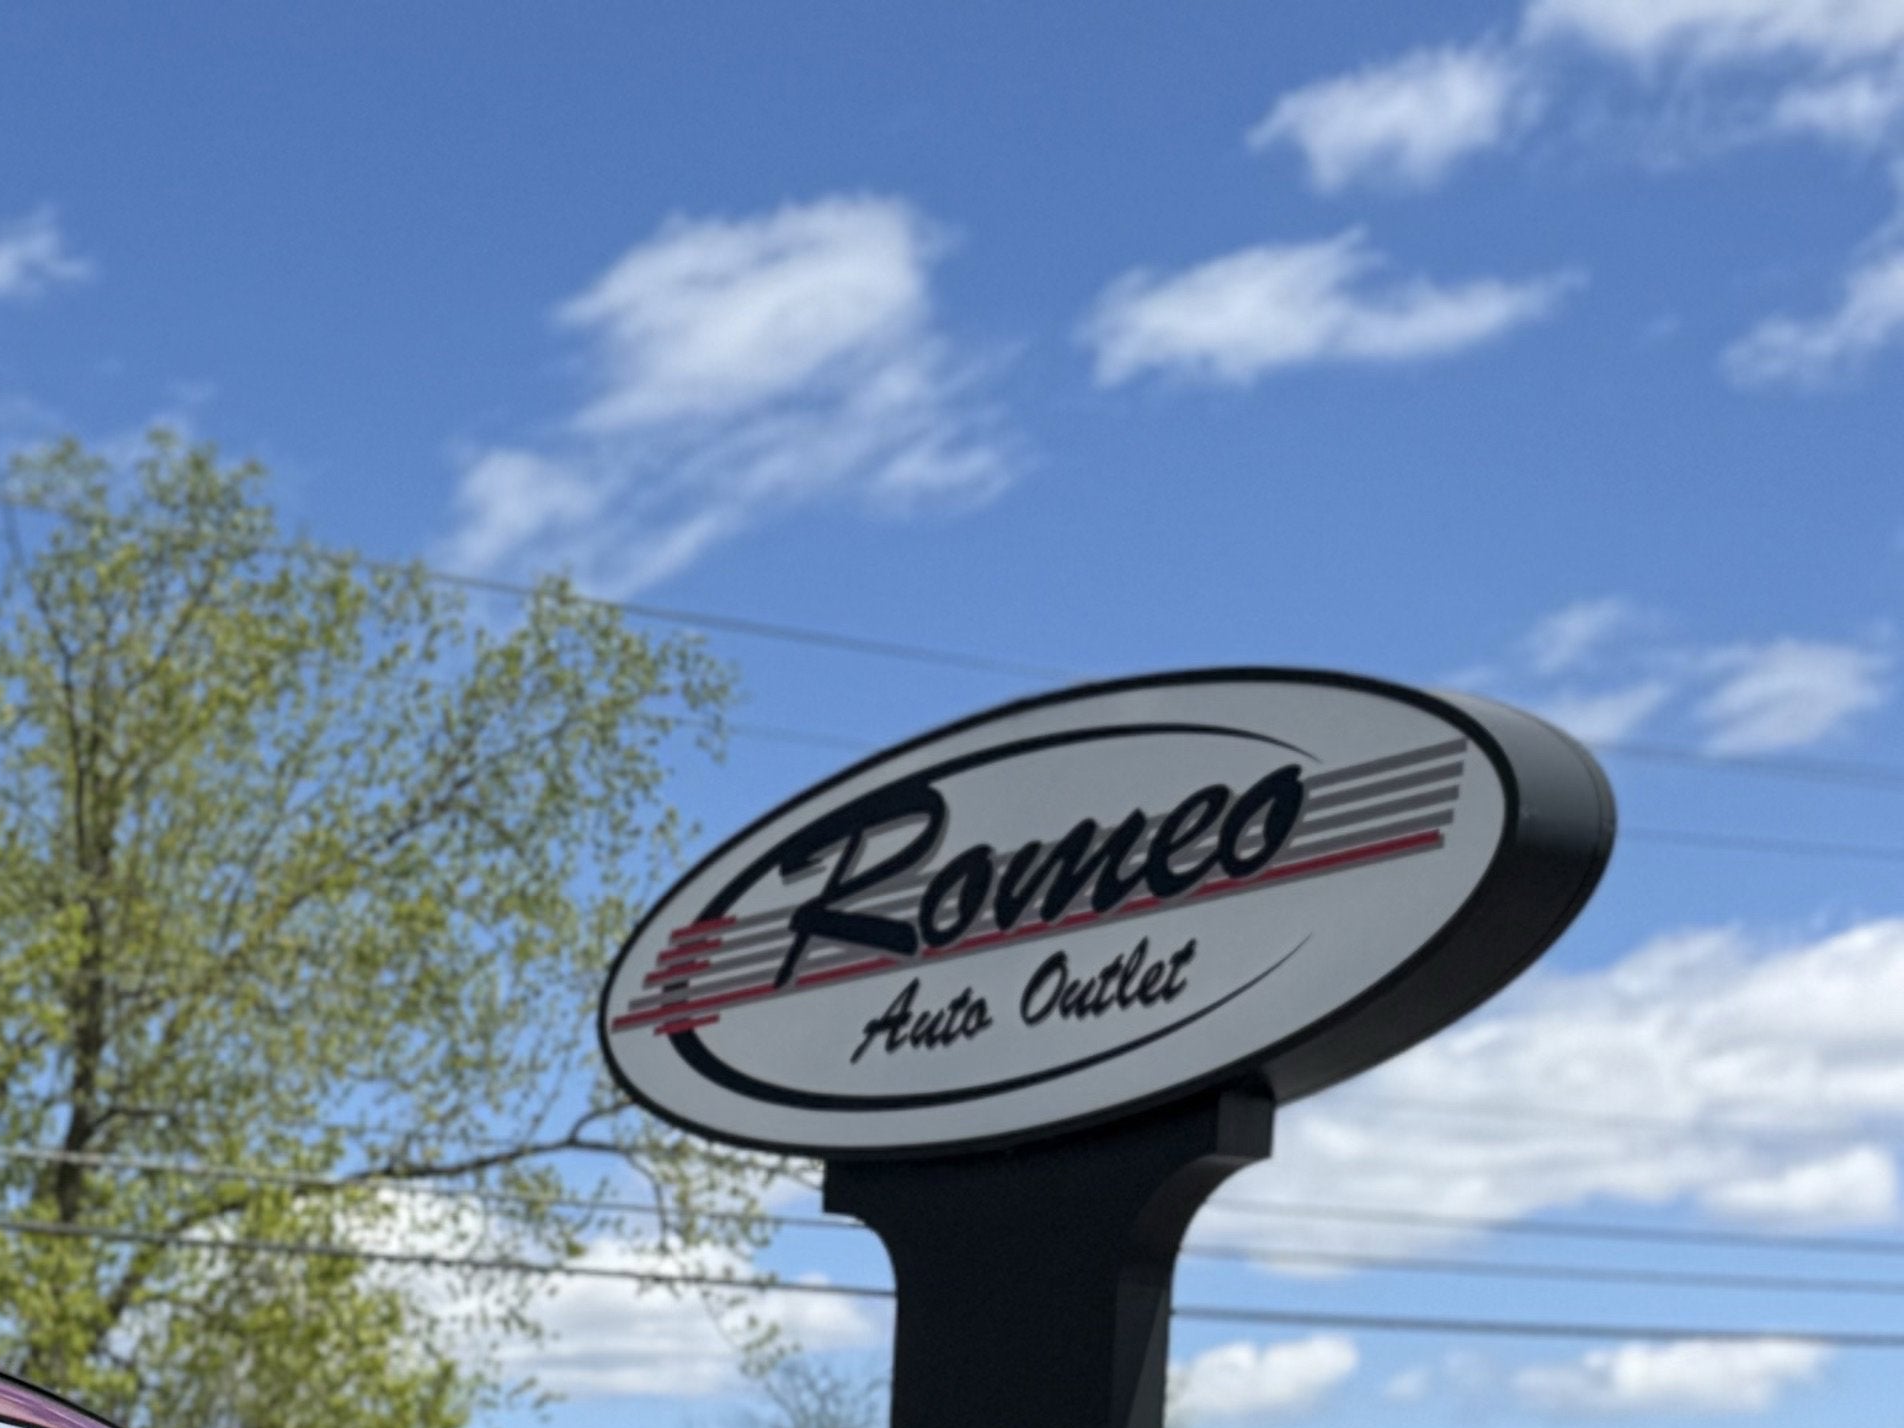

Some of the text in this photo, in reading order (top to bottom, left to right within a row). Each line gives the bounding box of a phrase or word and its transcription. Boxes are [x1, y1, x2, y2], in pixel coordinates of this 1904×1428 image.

[774, 763, 1306, 988] Romeo
[850, 937, 1197, 1064] Auto Outlet
